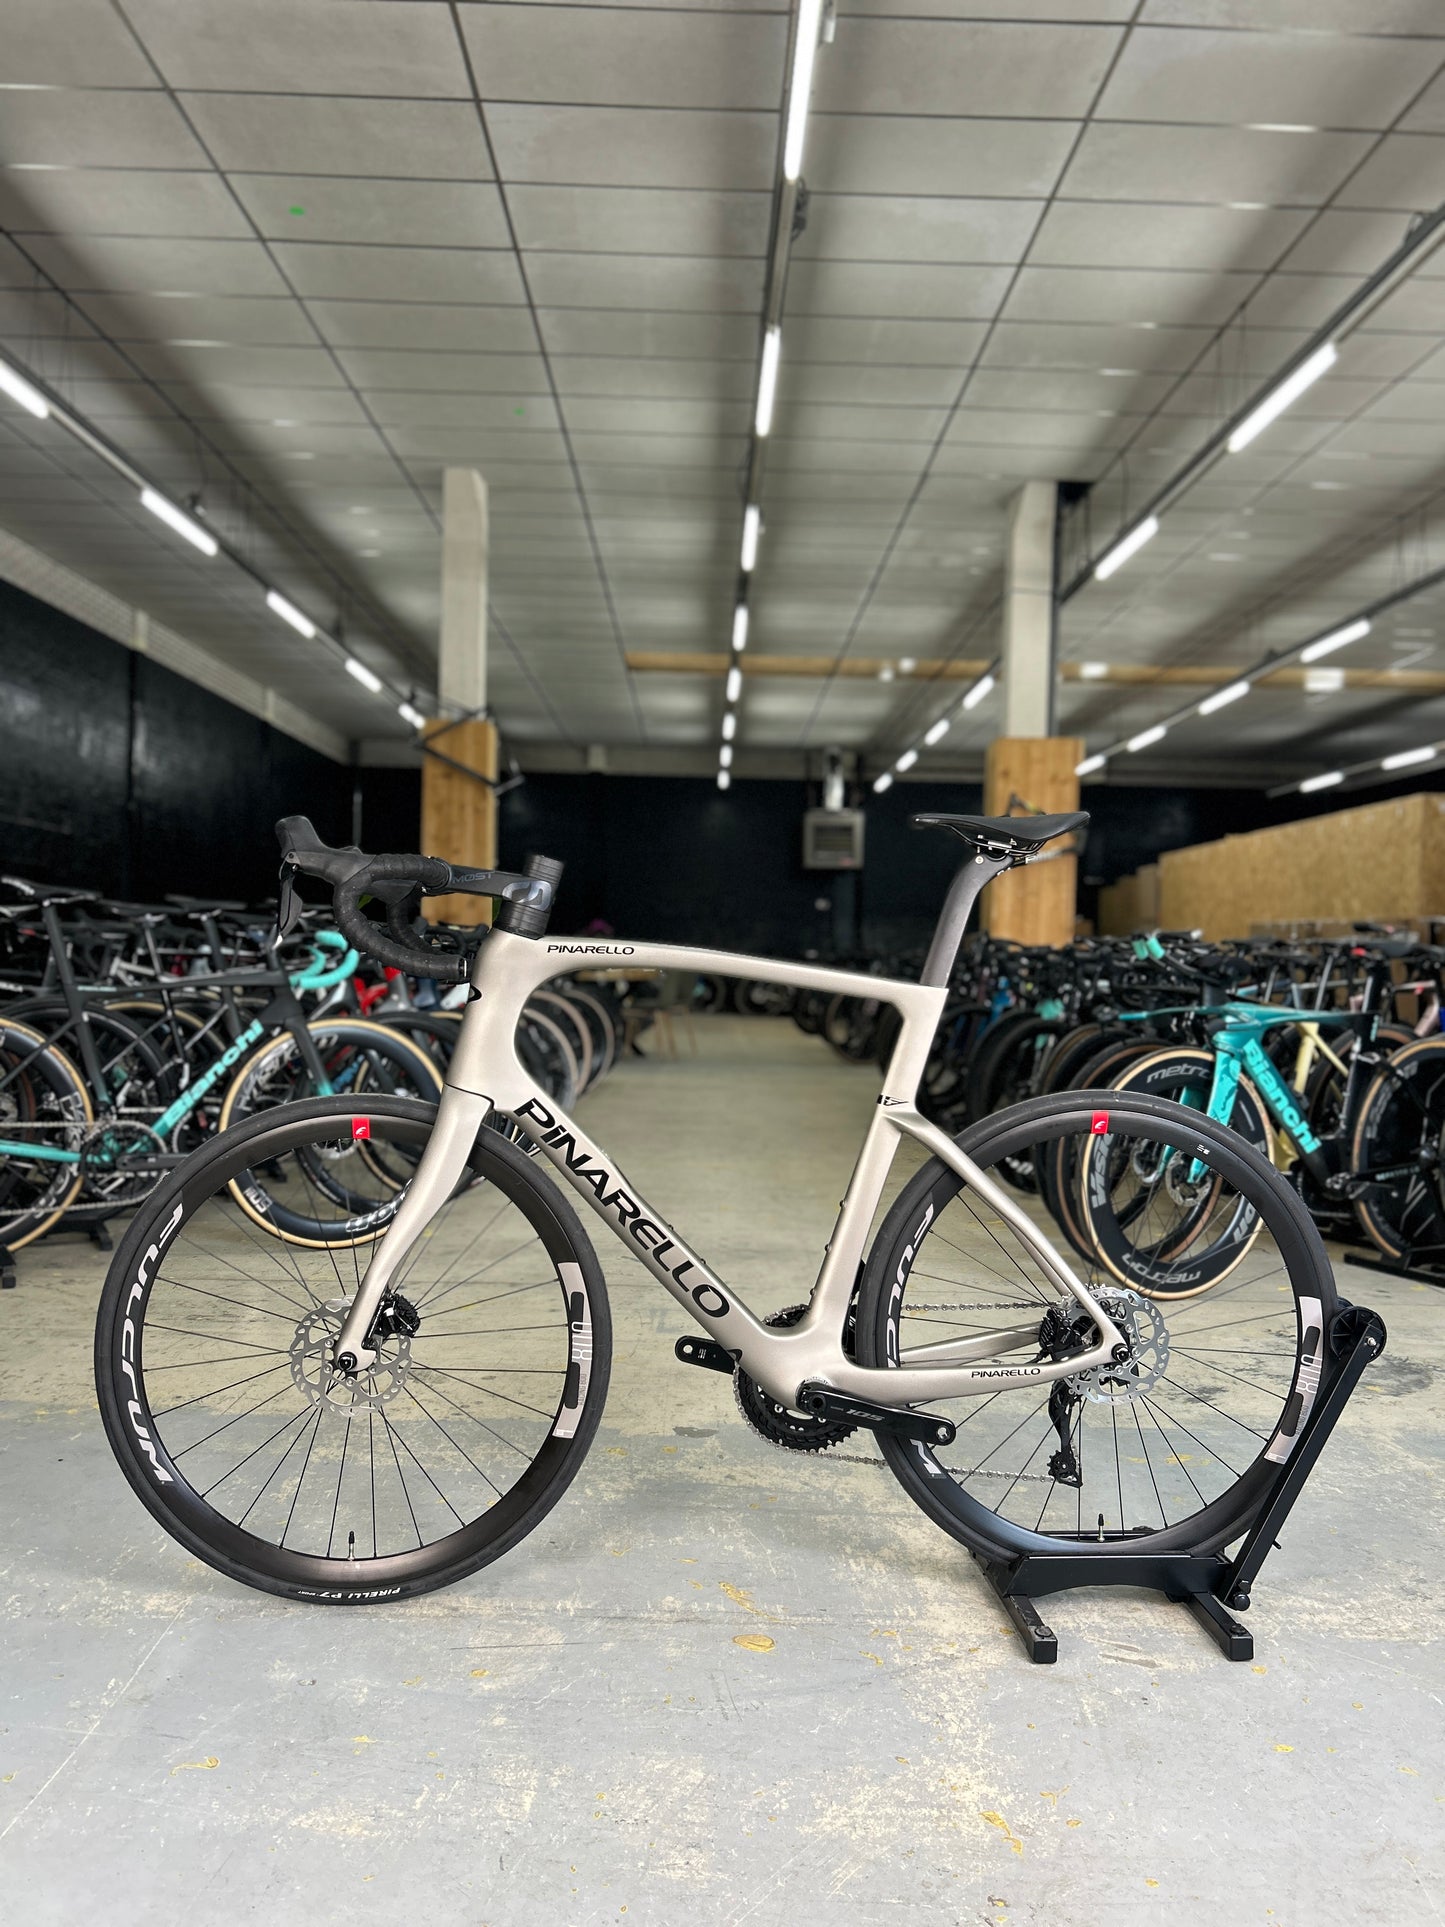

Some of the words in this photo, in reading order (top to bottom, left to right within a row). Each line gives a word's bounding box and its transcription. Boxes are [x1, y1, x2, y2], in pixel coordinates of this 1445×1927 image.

[547, 944, 635, 955] PINARELLO
[162, 1018, 264, 1129] Bianchi
[1243, 1038, 1322, 1154] Bianchi
[513, 1097, 730, 1318] PINARELLO
[121, 1202, 184, 1482] FULCRUM
[971, 1367, 1041, 1379] PINARELLO
[319, 1591, 342, 1599] P7
[348, 1587, 401, 1599] PIRELLI
